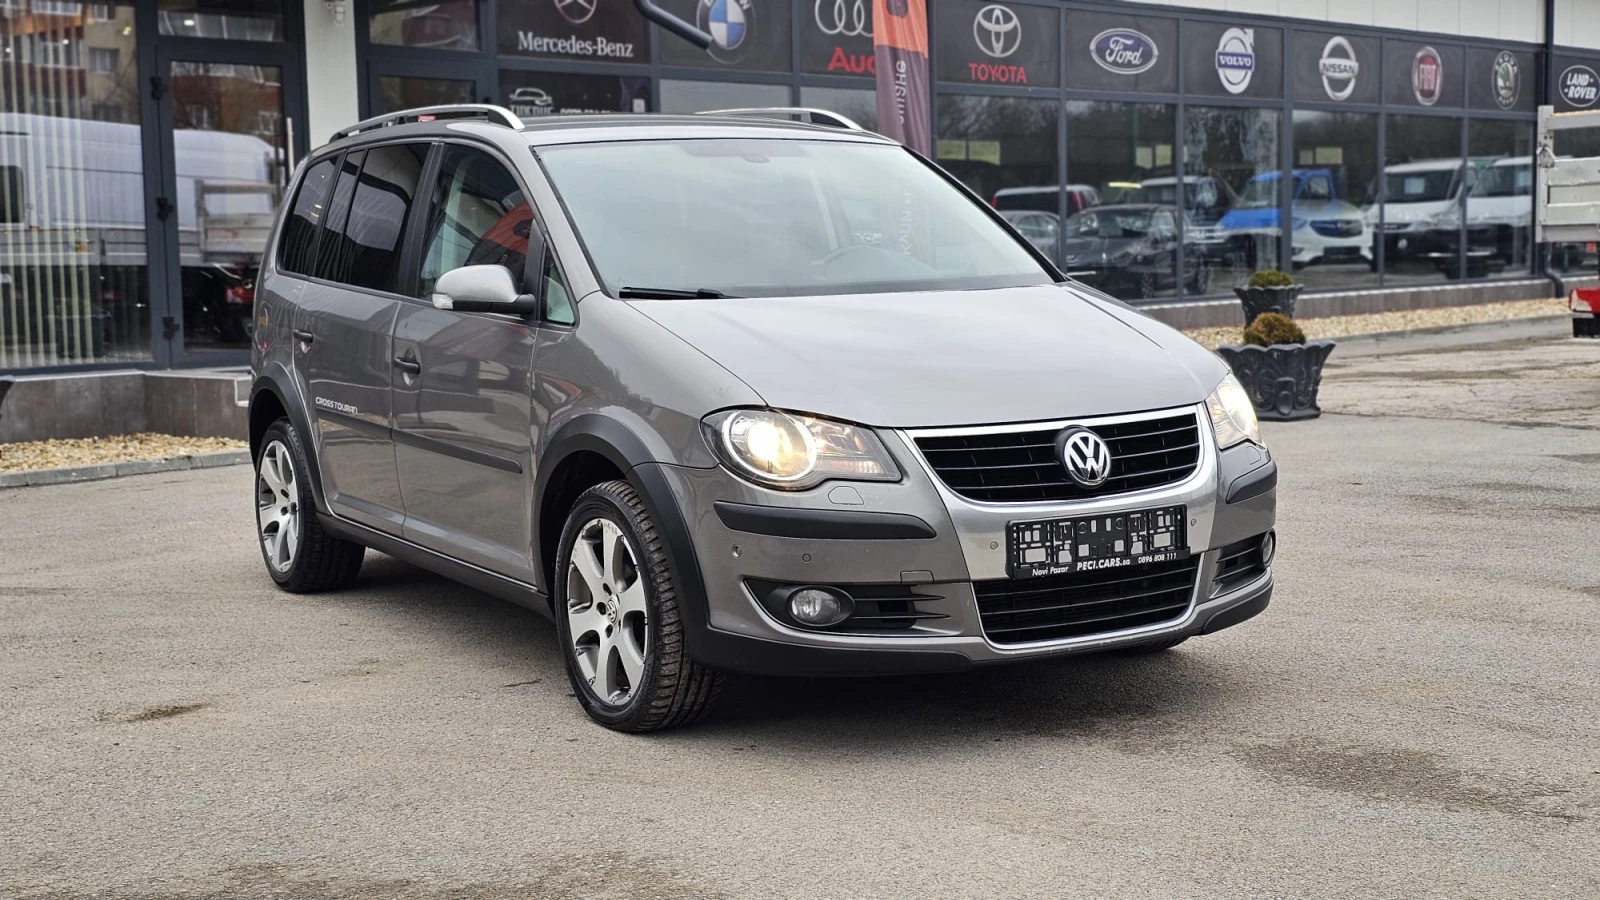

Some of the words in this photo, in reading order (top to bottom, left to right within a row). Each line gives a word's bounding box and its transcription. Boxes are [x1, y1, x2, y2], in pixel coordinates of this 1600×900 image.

[518, 31, 634, 57] Mercedes-Benz
[1105, 36, 1143, 65] Ford
[1219, 55, 1252, 67] VOLVO
[1322, 62, 1356, 74] NISSAN
[969, 63, 1027, 84] TOYOTA
[1032, 567, 1048, 576] Novi
[1138, 556, 1153, 564] 0896
[1154, 554, 1165, 562] 808
